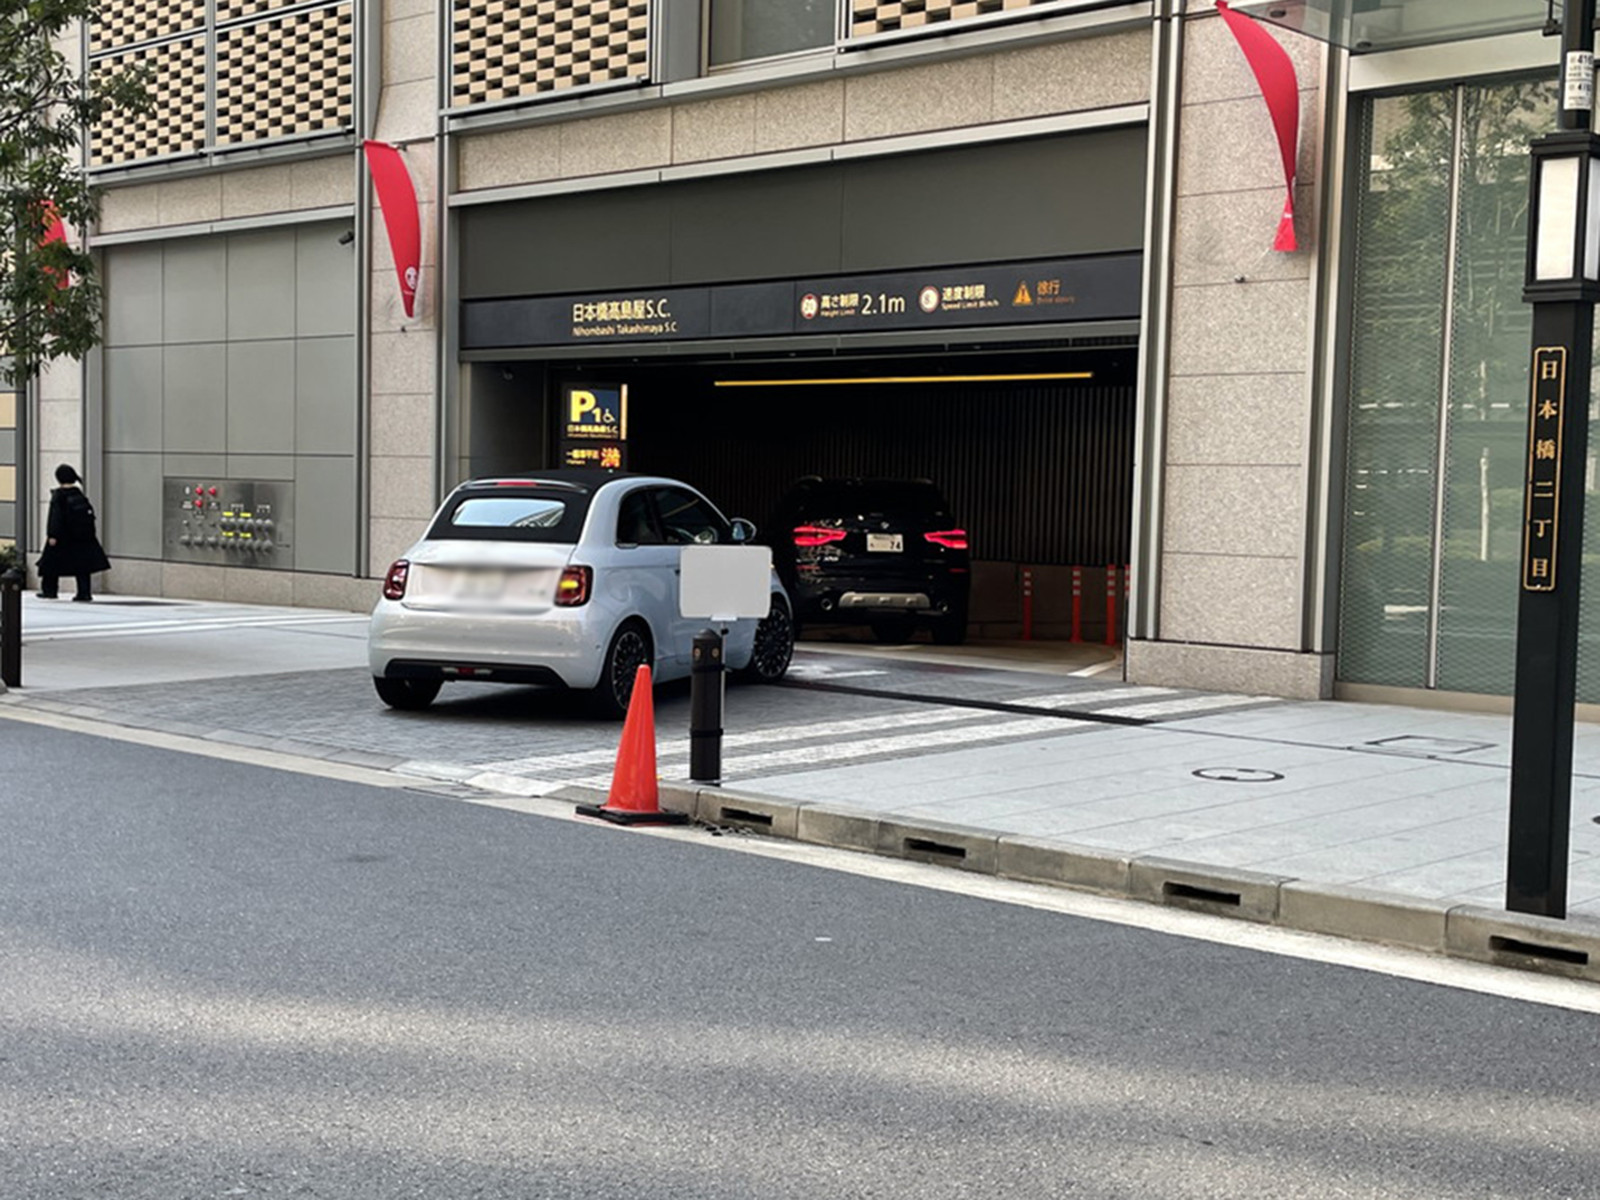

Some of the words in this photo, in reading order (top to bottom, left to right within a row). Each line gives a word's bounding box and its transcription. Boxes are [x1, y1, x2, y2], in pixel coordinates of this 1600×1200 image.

[942, 284, 985, 301] 速度制限
[821, 293, 859, 309] 高さ制限
[861, 293, 905, 315] 2.1m
[1532, 360, 1558, 577] 日本橋二丁目
